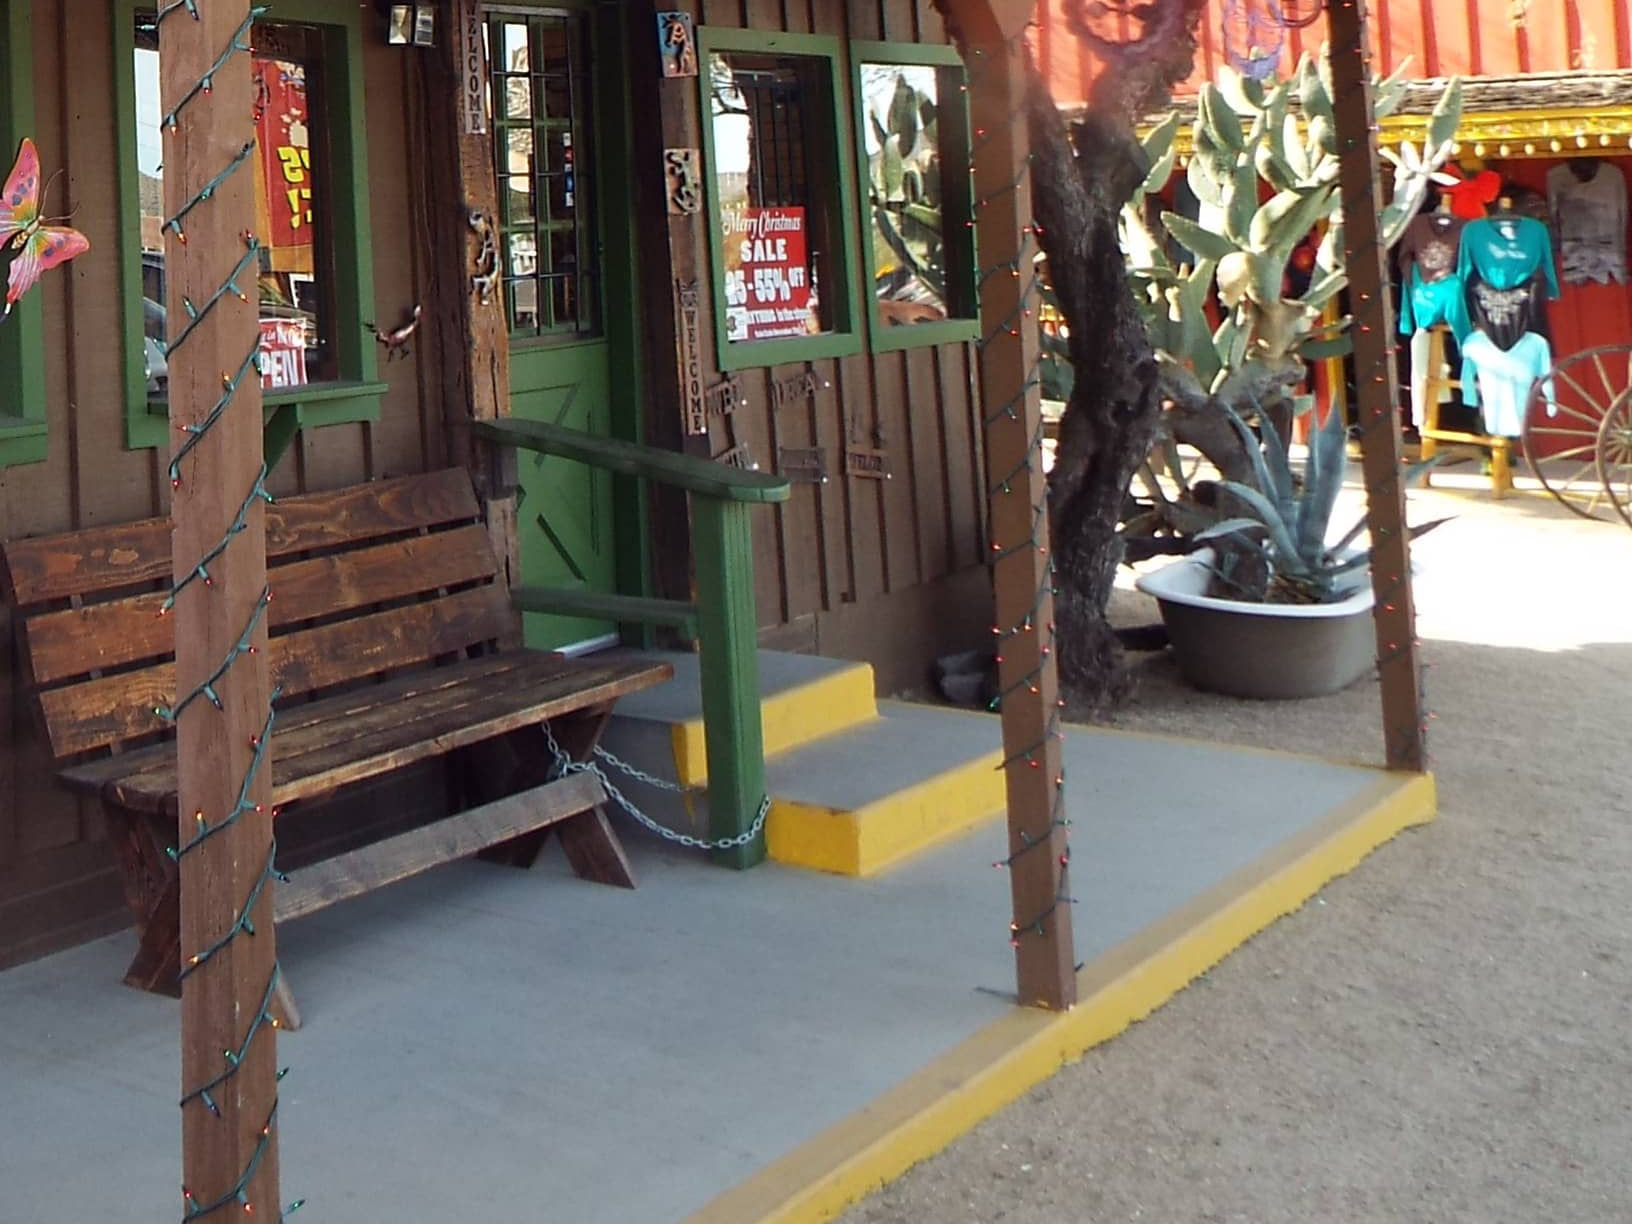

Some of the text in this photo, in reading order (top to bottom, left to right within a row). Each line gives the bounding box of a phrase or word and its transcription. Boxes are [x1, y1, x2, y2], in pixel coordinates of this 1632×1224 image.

[722, 210, 801, 239] Merry Christmas
[740, 238, 788, 262] SALE
[261, 349, 300, 388] PEN
[683, 309, 703, 431] WELCOME
